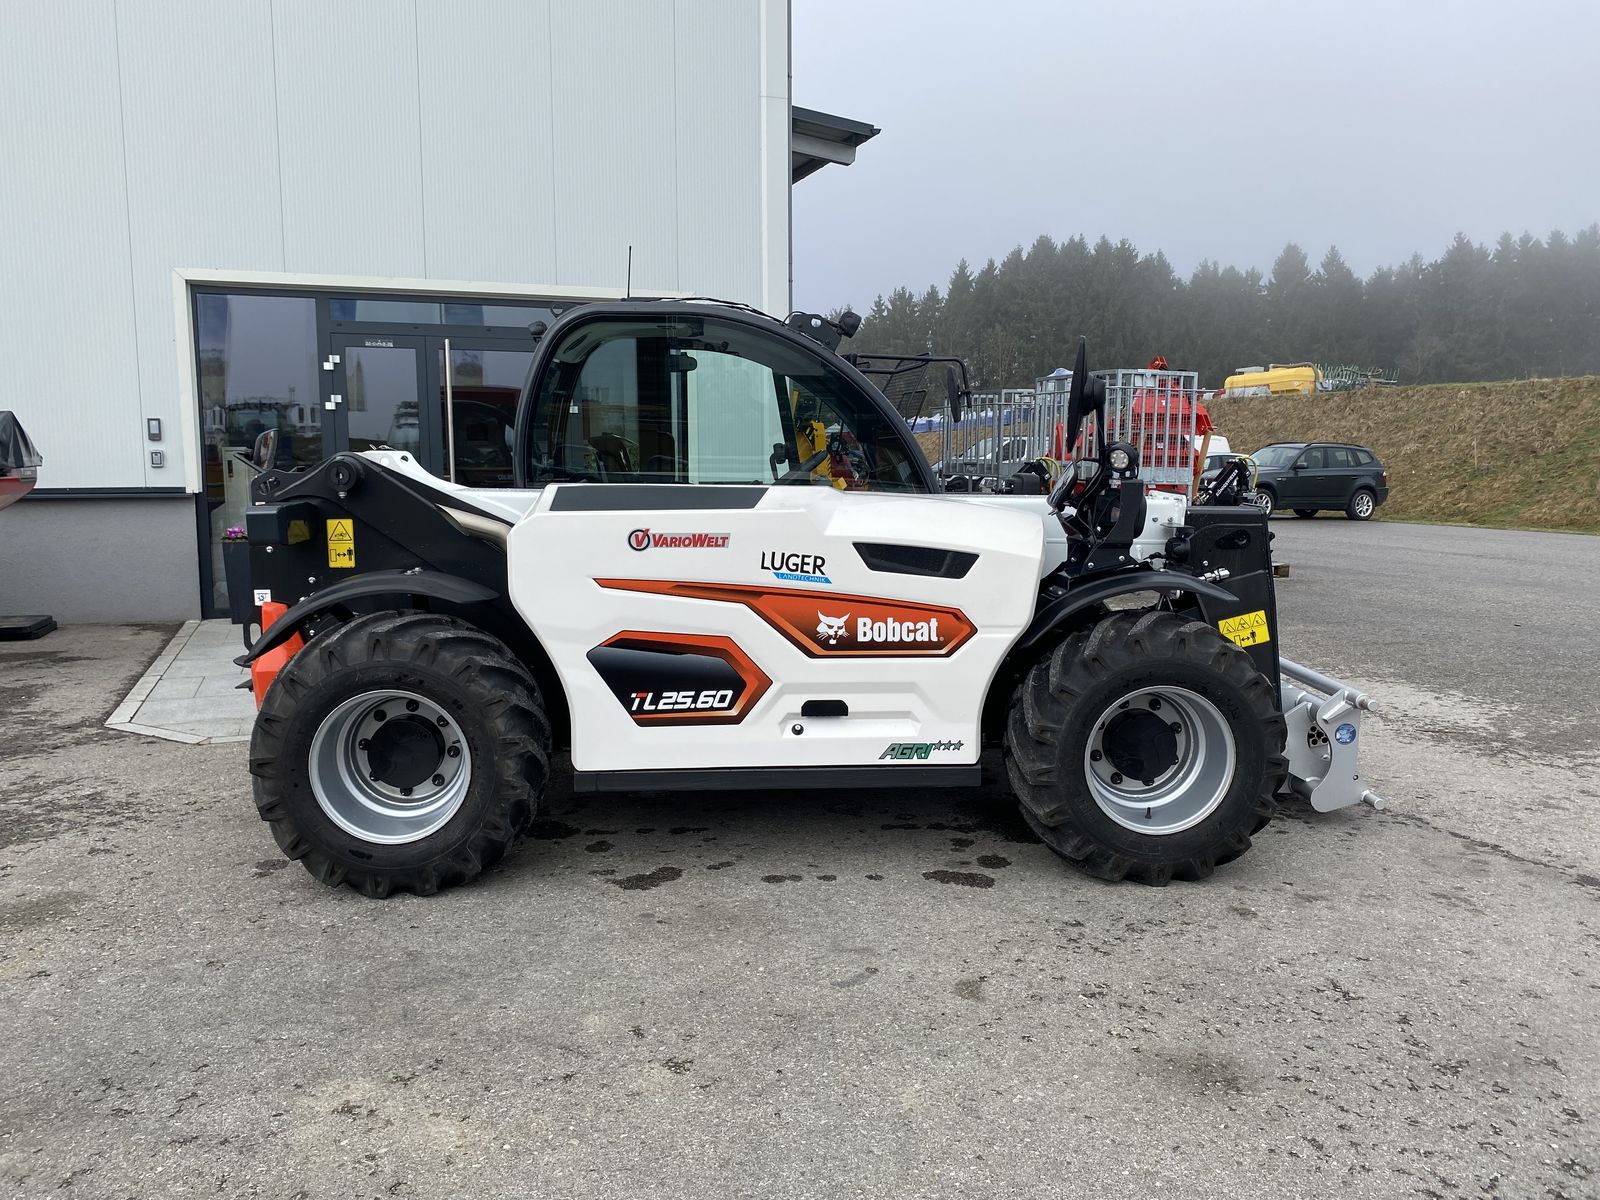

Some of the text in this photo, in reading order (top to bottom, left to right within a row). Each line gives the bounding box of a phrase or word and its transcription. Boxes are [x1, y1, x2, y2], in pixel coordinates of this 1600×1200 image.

[760, 551, 826, 576] LUGER
[778, 573, 826, 583] LANDTECHNIK
[857, 617, 938, 642] Bobcat
[630, 690, 734, 711] TL25.60
[878, 742, 933, 760] AGRI
